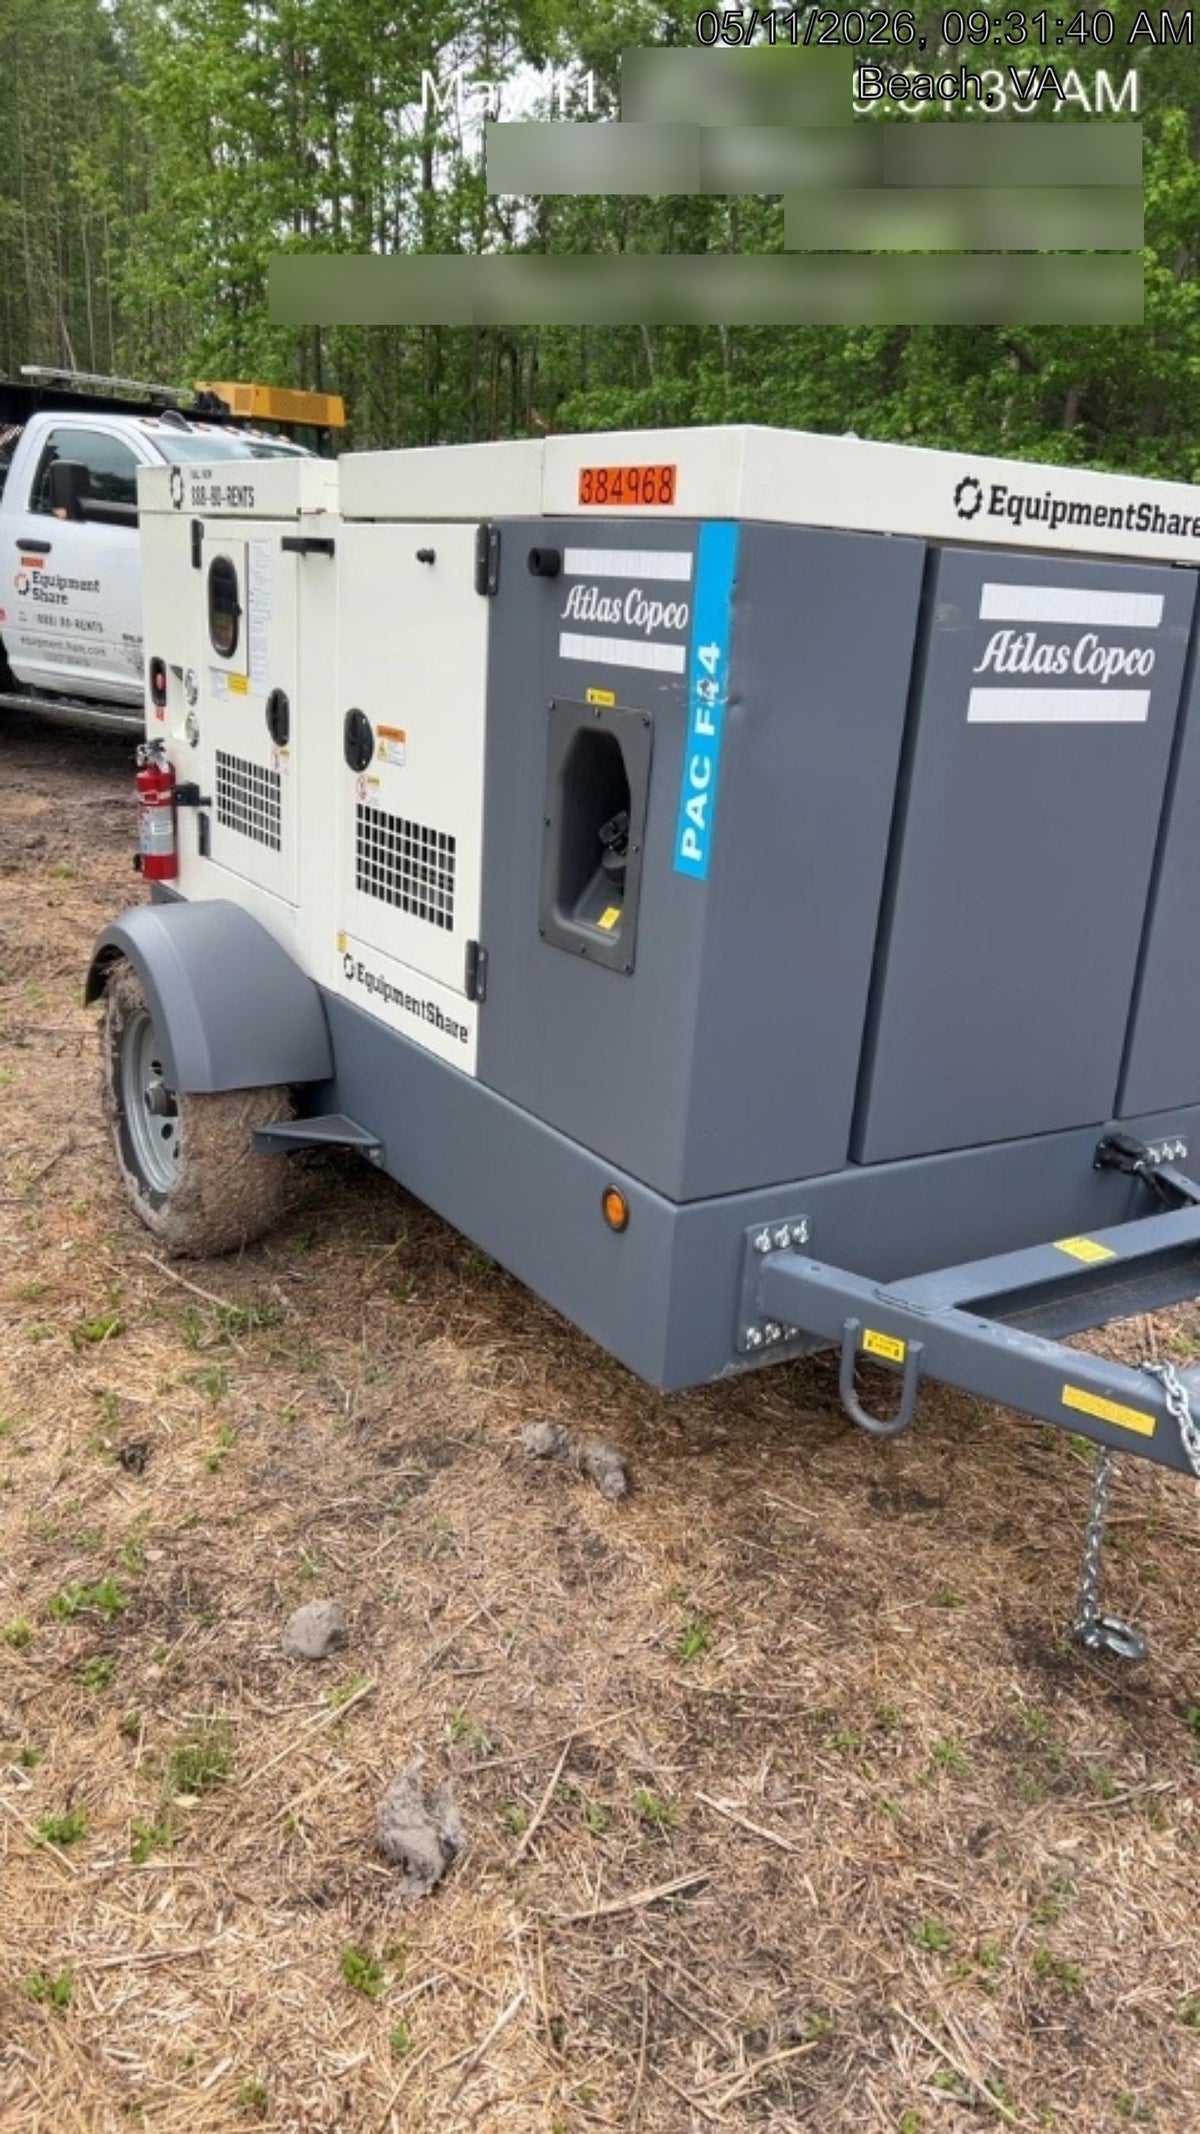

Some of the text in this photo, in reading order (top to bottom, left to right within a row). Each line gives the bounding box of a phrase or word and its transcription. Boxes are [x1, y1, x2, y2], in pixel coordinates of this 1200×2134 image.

[580, 467, 673, 504] 384968
[988, 485, 1200, 537] EquipmentShare
[32, 571, 100, 593] Equipment
[32, 588, 68, 605] Share
[560, 584, 690, 635] Atlas Copco
[972, 630, 1155, 683] Atlas Copco
[680, 754, 711, 861] PAC
[357, 962, 468, 1044] EquipmentShare
